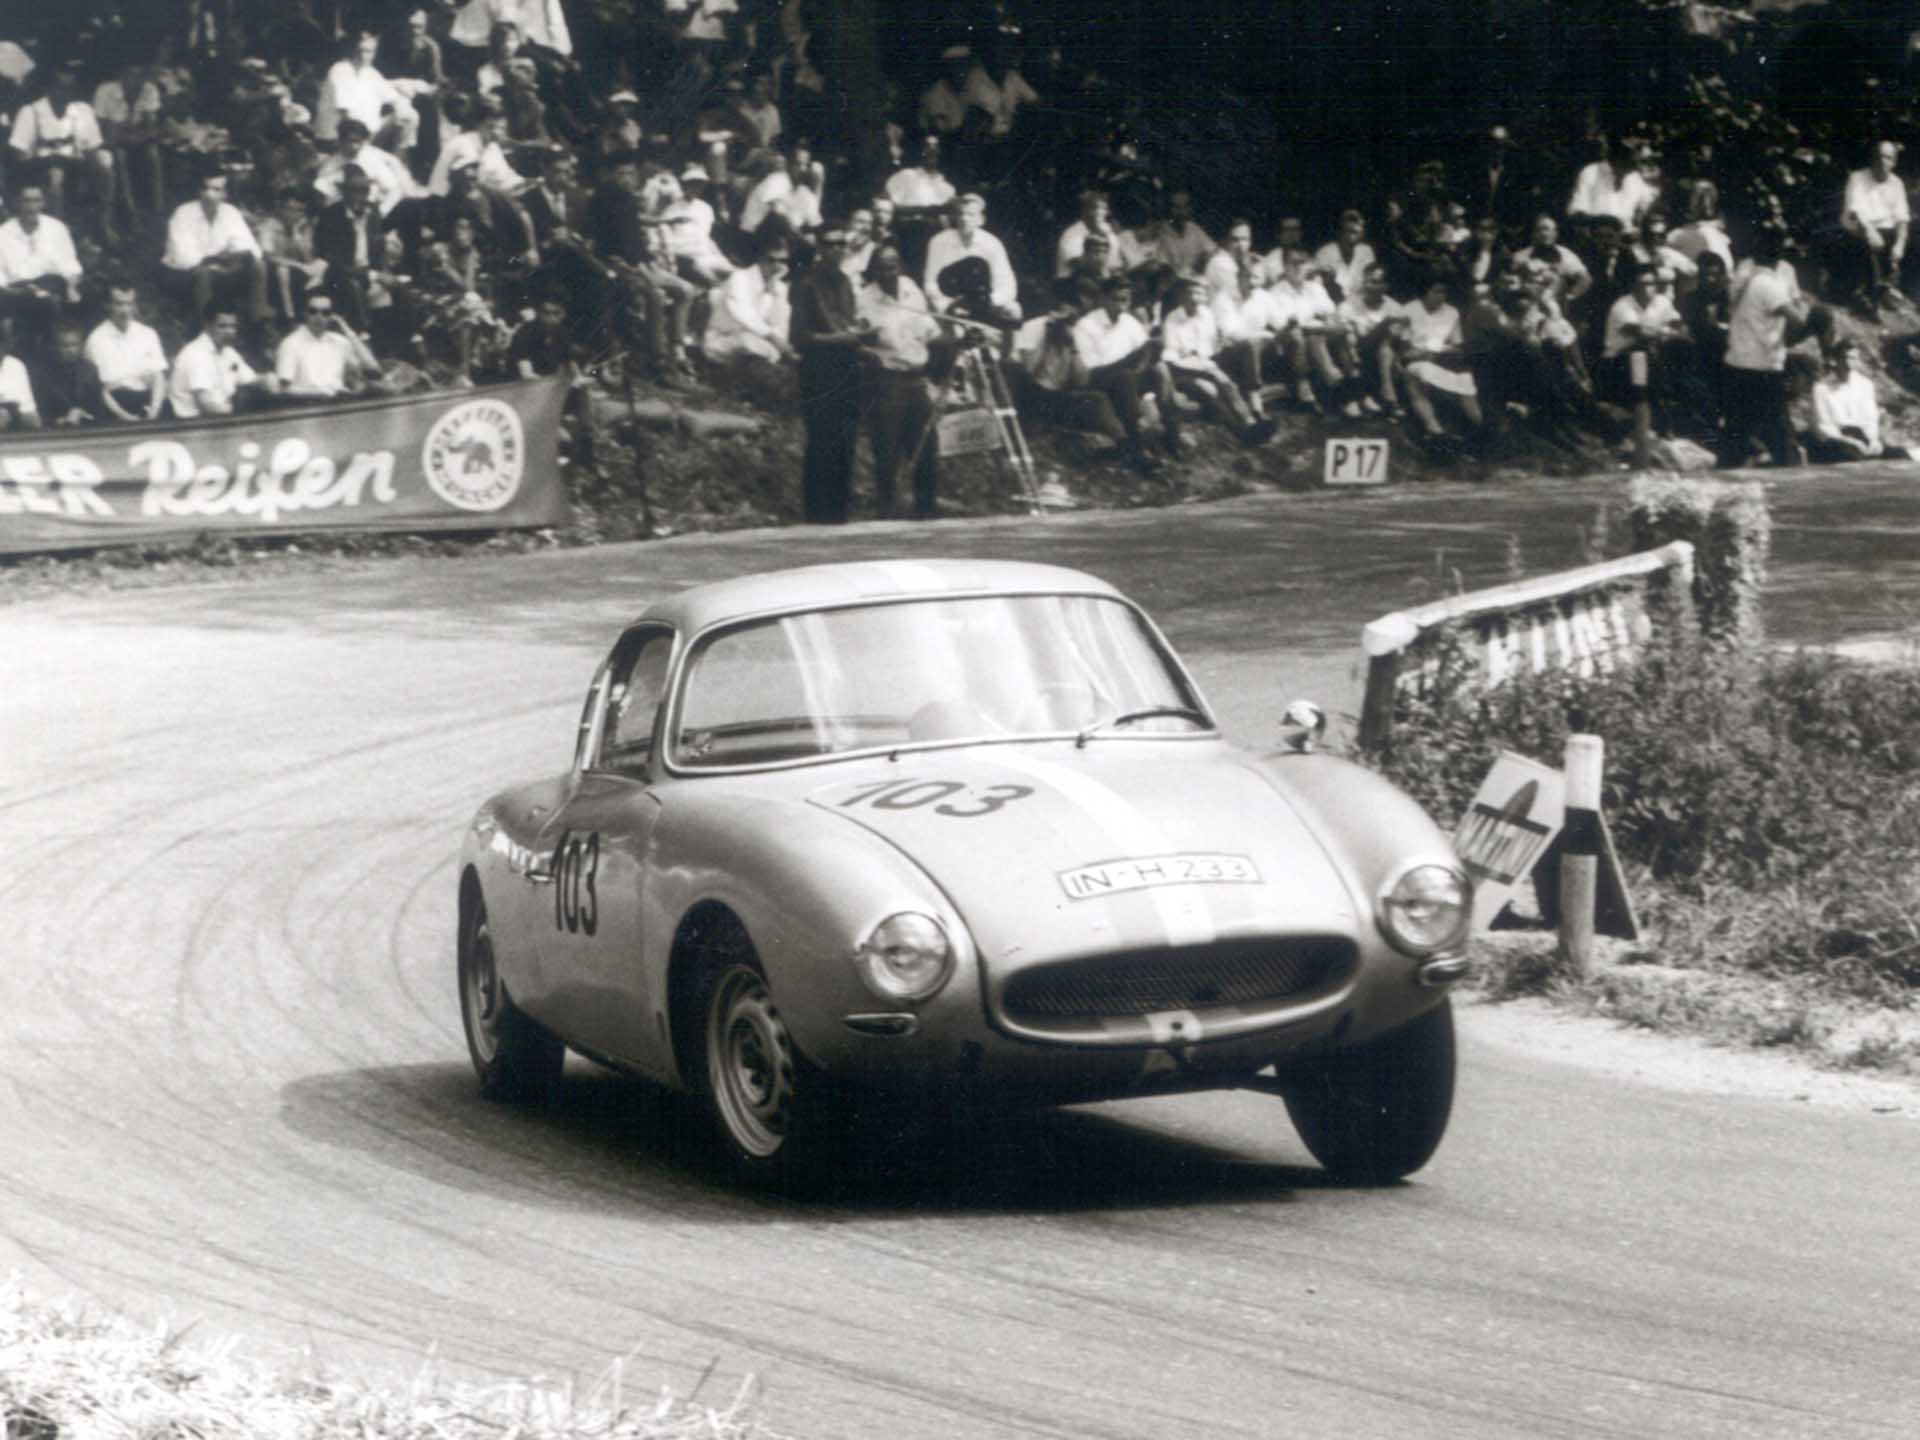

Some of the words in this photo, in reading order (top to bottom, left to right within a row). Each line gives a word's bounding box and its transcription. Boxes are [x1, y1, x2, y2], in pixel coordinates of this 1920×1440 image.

[128, 437, 398, 522] Reifen
[837, 777, 1036, 818] 103
[551, 829, 599, 937] 103
